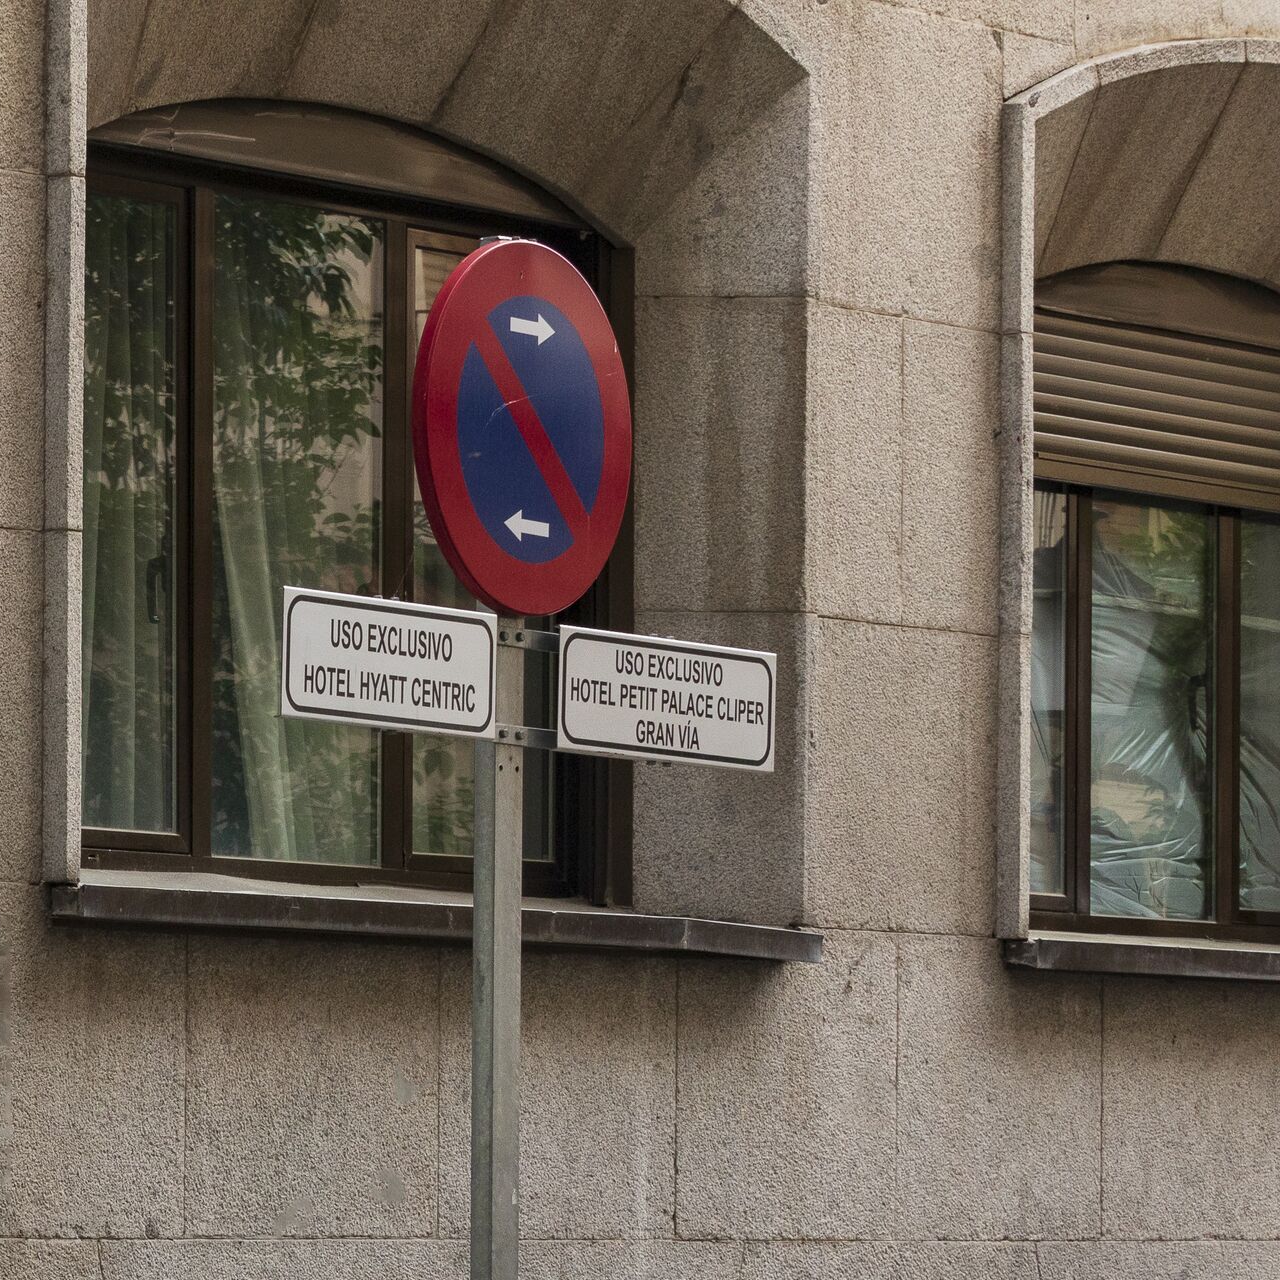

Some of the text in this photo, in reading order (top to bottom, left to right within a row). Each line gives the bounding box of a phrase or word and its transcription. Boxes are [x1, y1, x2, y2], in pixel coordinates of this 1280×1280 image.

[330, 618, 453, 663] USO EXCLUSIVO
[303, 663, 476, 713] HOTEL HYATT CENTRIC
[615, 649, 723, 687] USO EXCLUSIVO
[570, 676, 764, 725] HOTEL PETIT PALACE CLIPER
[635, 719, 700, 750] GRAN VÍA
